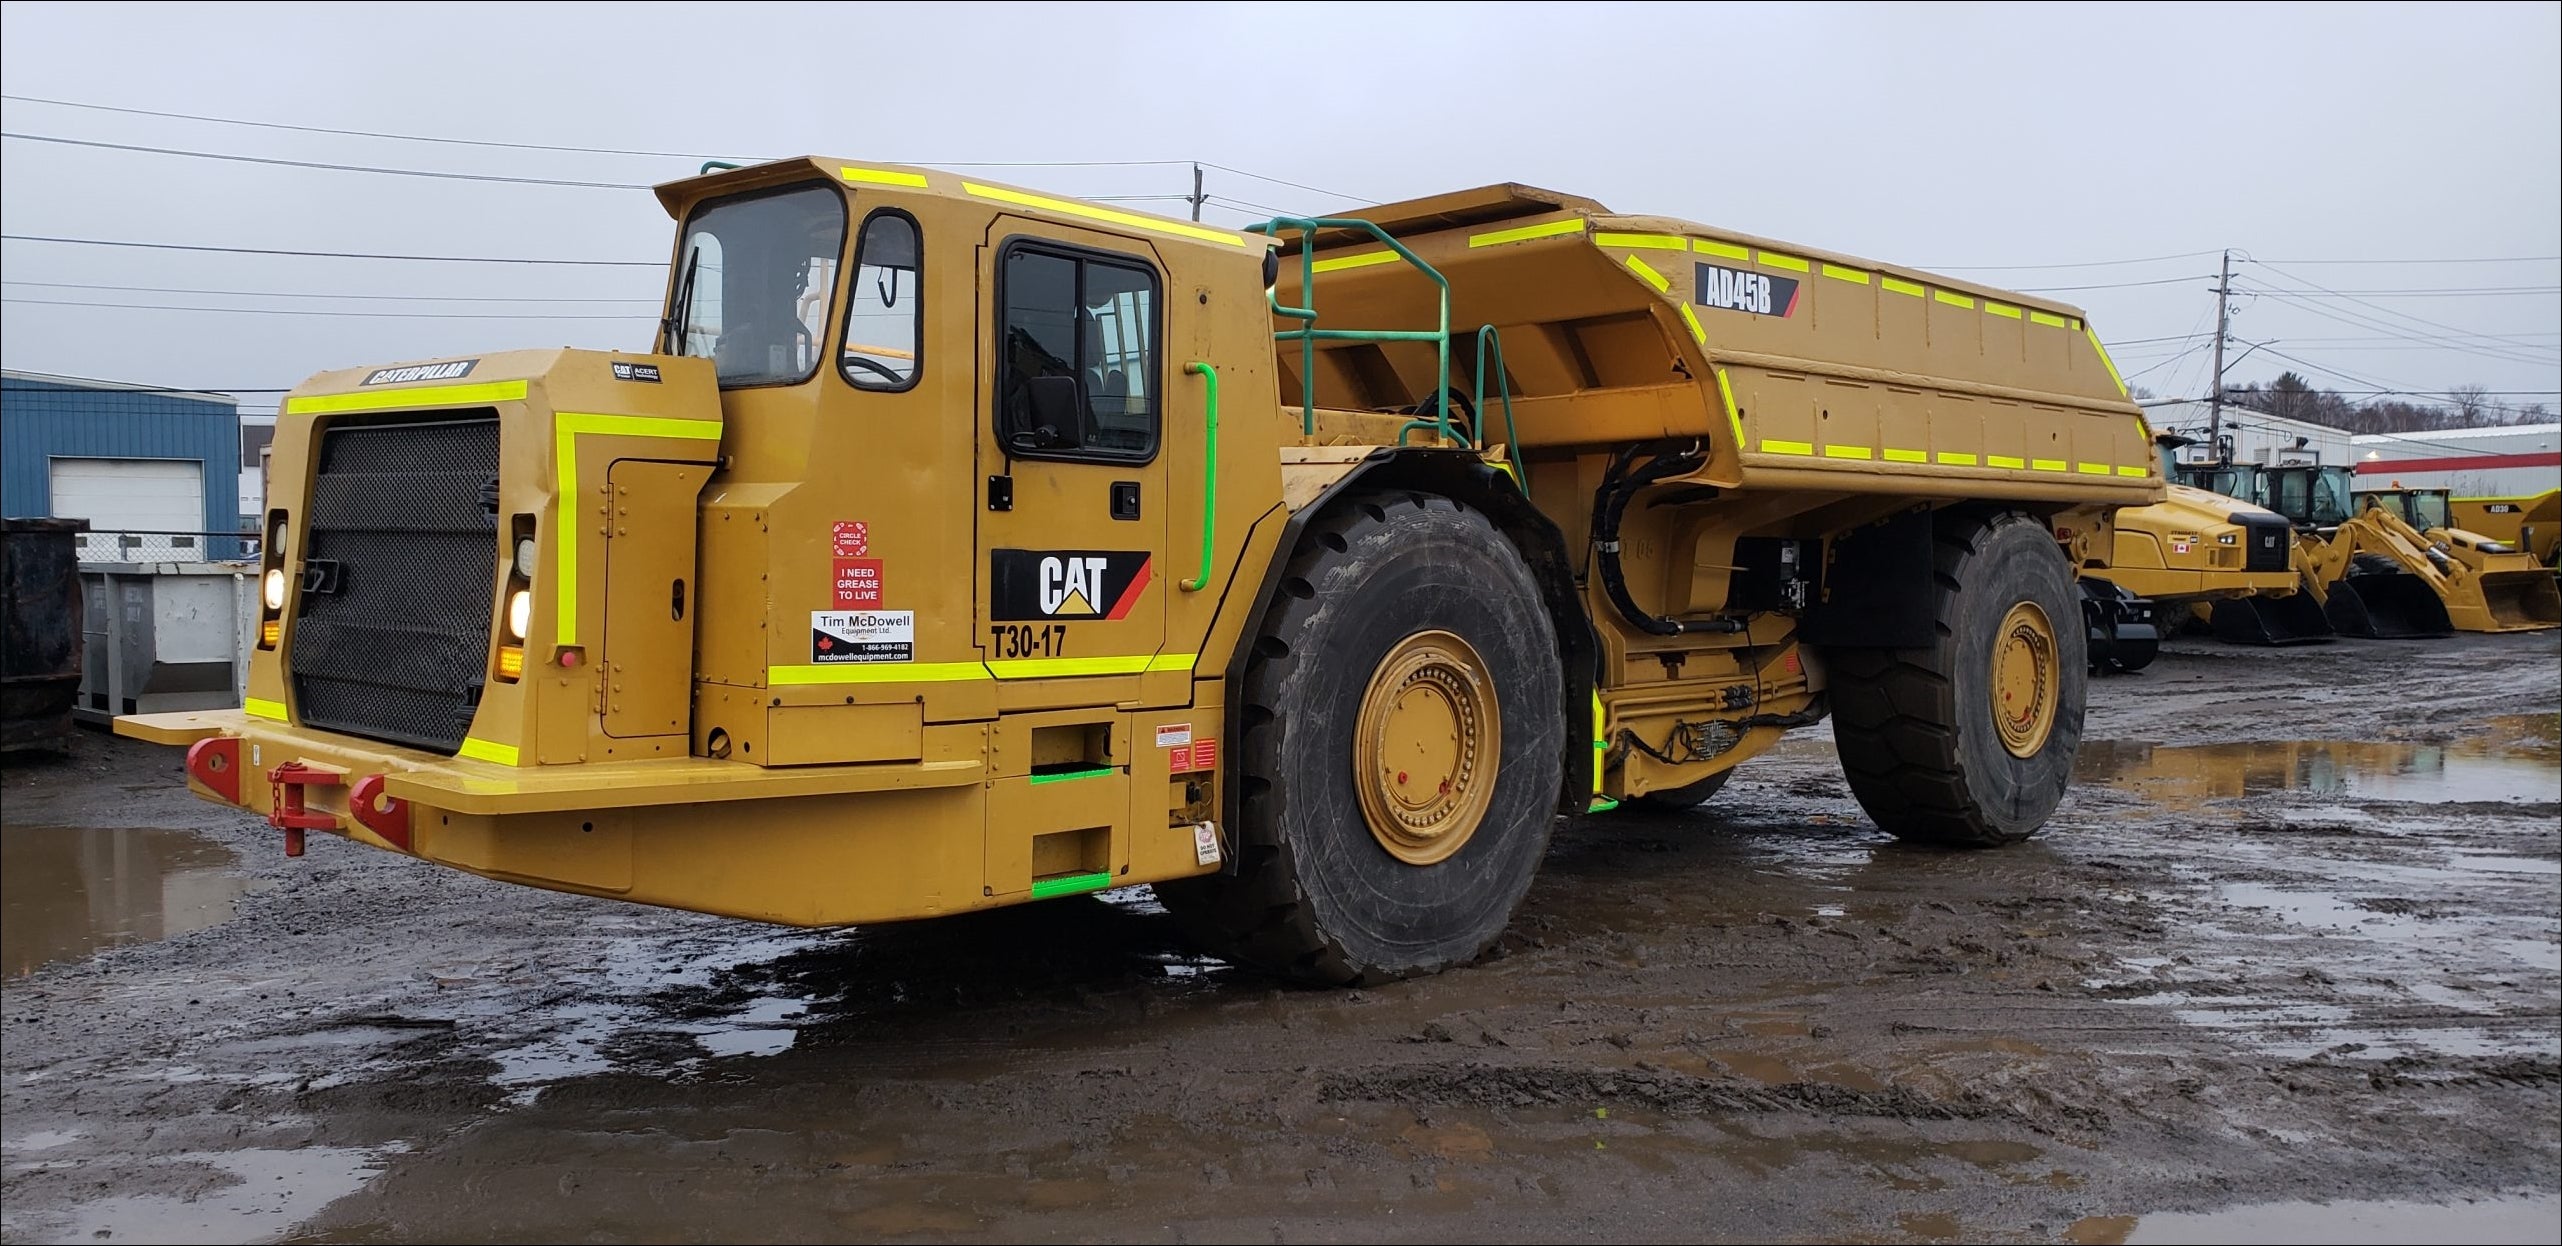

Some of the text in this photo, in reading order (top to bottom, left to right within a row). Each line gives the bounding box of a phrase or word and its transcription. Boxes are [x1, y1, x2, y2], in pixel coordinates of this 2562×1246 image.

[1706, 266, 1771, 314] AD45B
[368, 361, 470, 385] CATERPILLAR
[613, 364, 658, 375] CAT ACERT
[2490, 505, 2509, 513] AD30
[841, 568, 875, 578] I NEED
[837, 579, 879, 589] GREASE
[1039, 556, 1108, 615] CAT
[838, 591, 878, 600] TO LIVE
[821, 615, 910, 627] Tim McDowell
[841, 627, 877, 636] Equipment
[991, 625, 1067, 658] T30-17
[818, 651, 909, 662] mcdowellequipment.com
